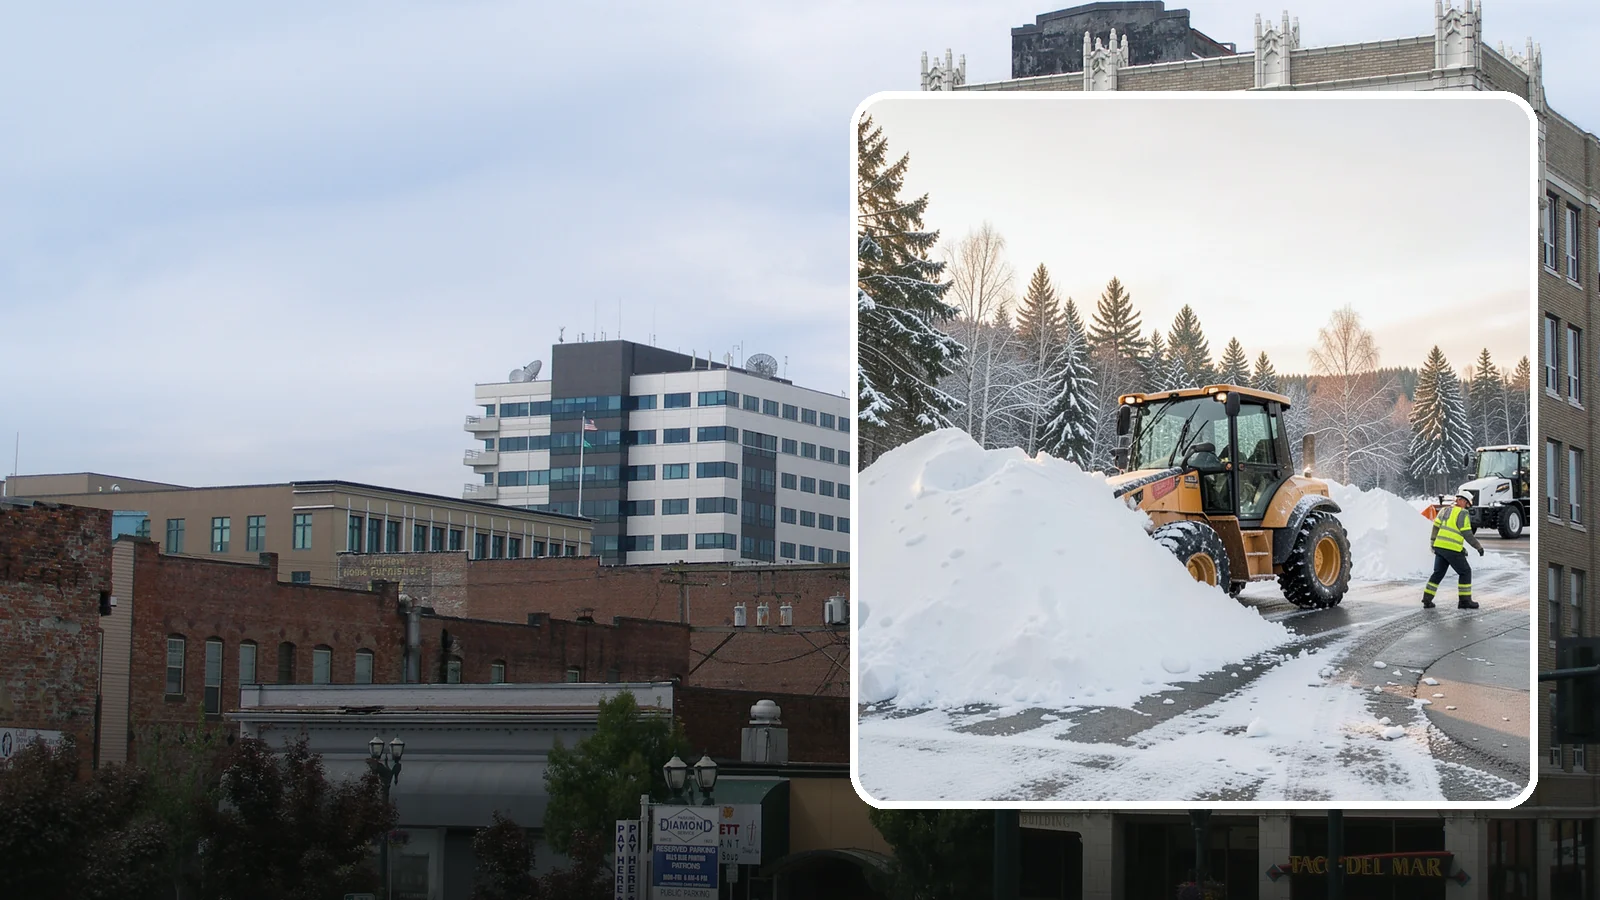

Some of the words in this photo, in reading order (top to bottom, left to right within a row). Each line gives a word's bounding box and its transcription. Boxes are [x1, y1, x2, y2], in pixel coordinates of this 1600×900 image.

[343, 568, 368, 577] Home
[370, 566, 427, 577] Furnishers
[660, 818, 713, 833] DIAMOND
[1022, 815, 1069, 828] BUILDING
[617, 825, 625, 852] PAY
[628, 824, 636, 852] PAY
[689, 846, 716, 854] PARKING
[721, 851, 739, 862] Soup
[671, 862, 701, 870] PATRONS
[1346, 856, 1386, 876] DEL
[1392, 857, 1443, 877] MAR
[616, 856, 625, 893] HERE
[627, 855, 636, 893] HERE
[660, 889, 681, 897] PUBLIC
[683, 889, 710, 898] PARKING
